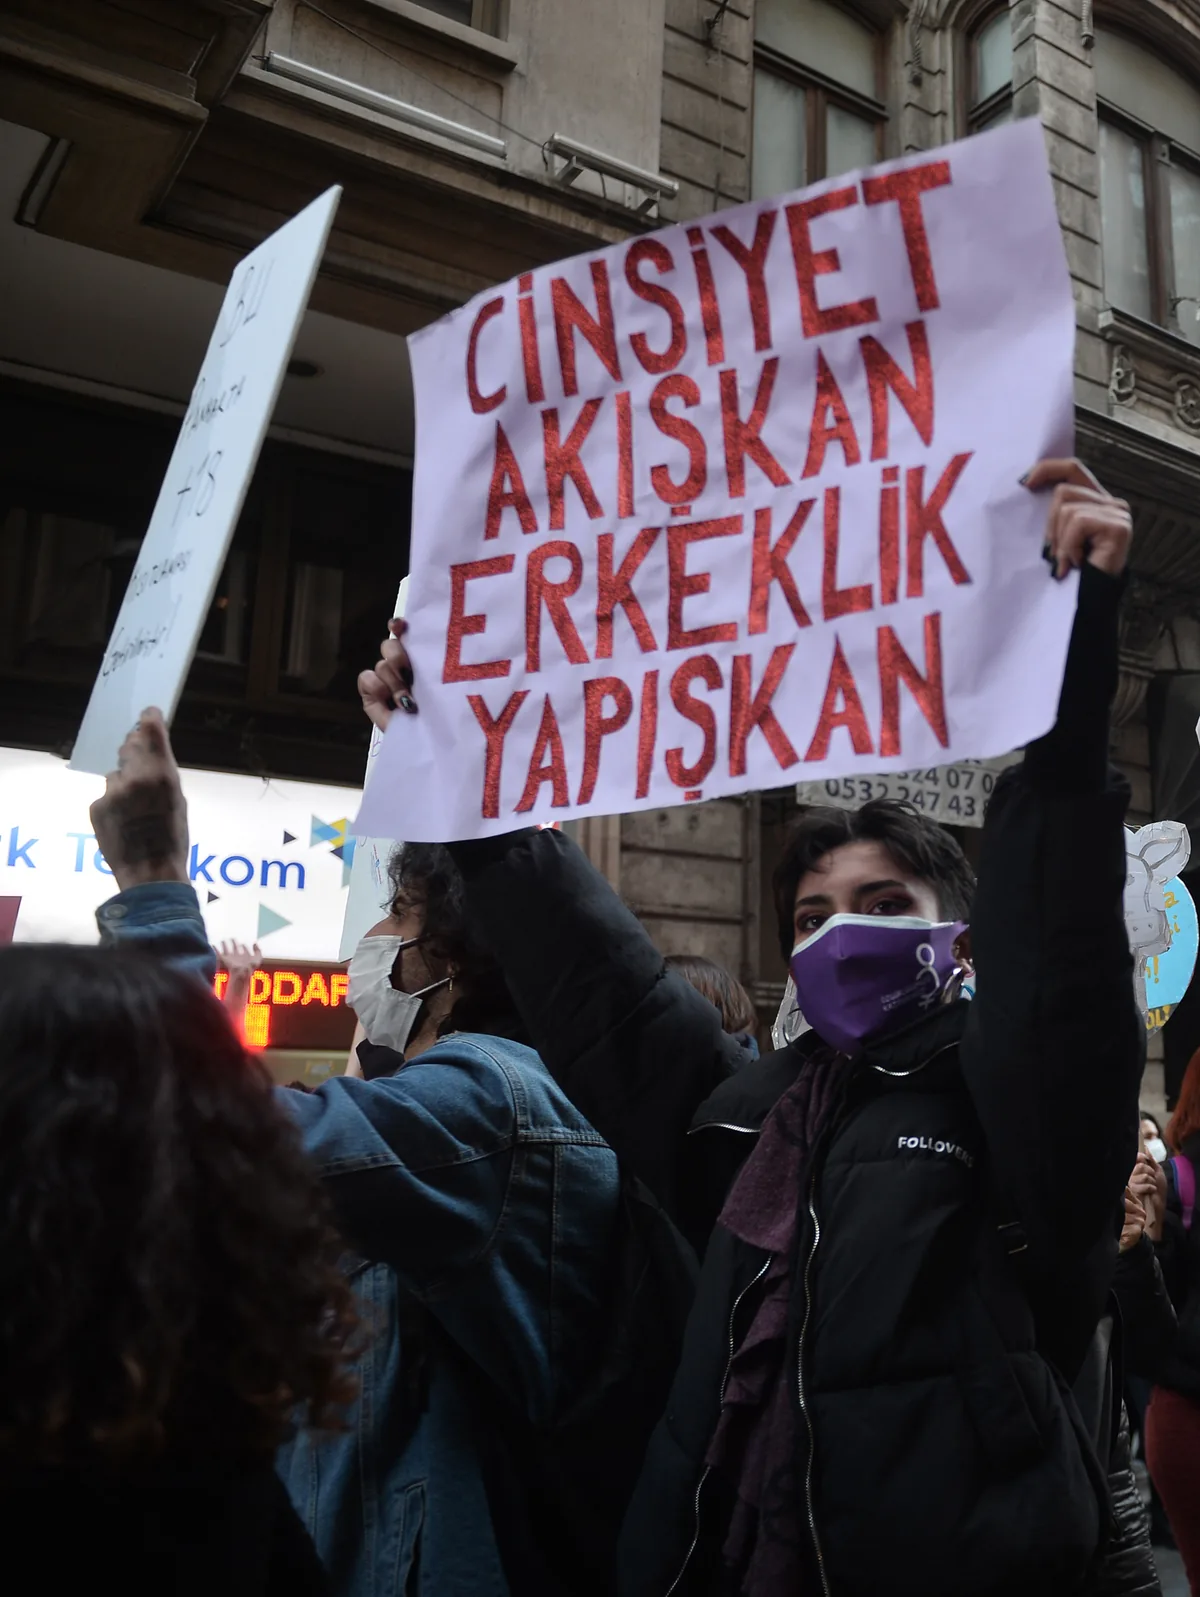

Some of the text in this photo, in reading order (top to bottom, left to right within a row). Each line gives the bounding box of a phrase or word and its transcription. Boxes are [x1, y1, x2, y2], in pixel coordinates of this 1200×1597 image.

[466, 160, 951, 414] CİNSİYET
[484, 321, 935, 540] AKIŞKAN
[442, 451, 974, 685] ERKEKLİK
[467, 612, 949, 820] YAPIŞKAN
[947, 767, 975, 790] 07
[982, 773, 996, 793] 0
[948, 795, 976, 816] 43
